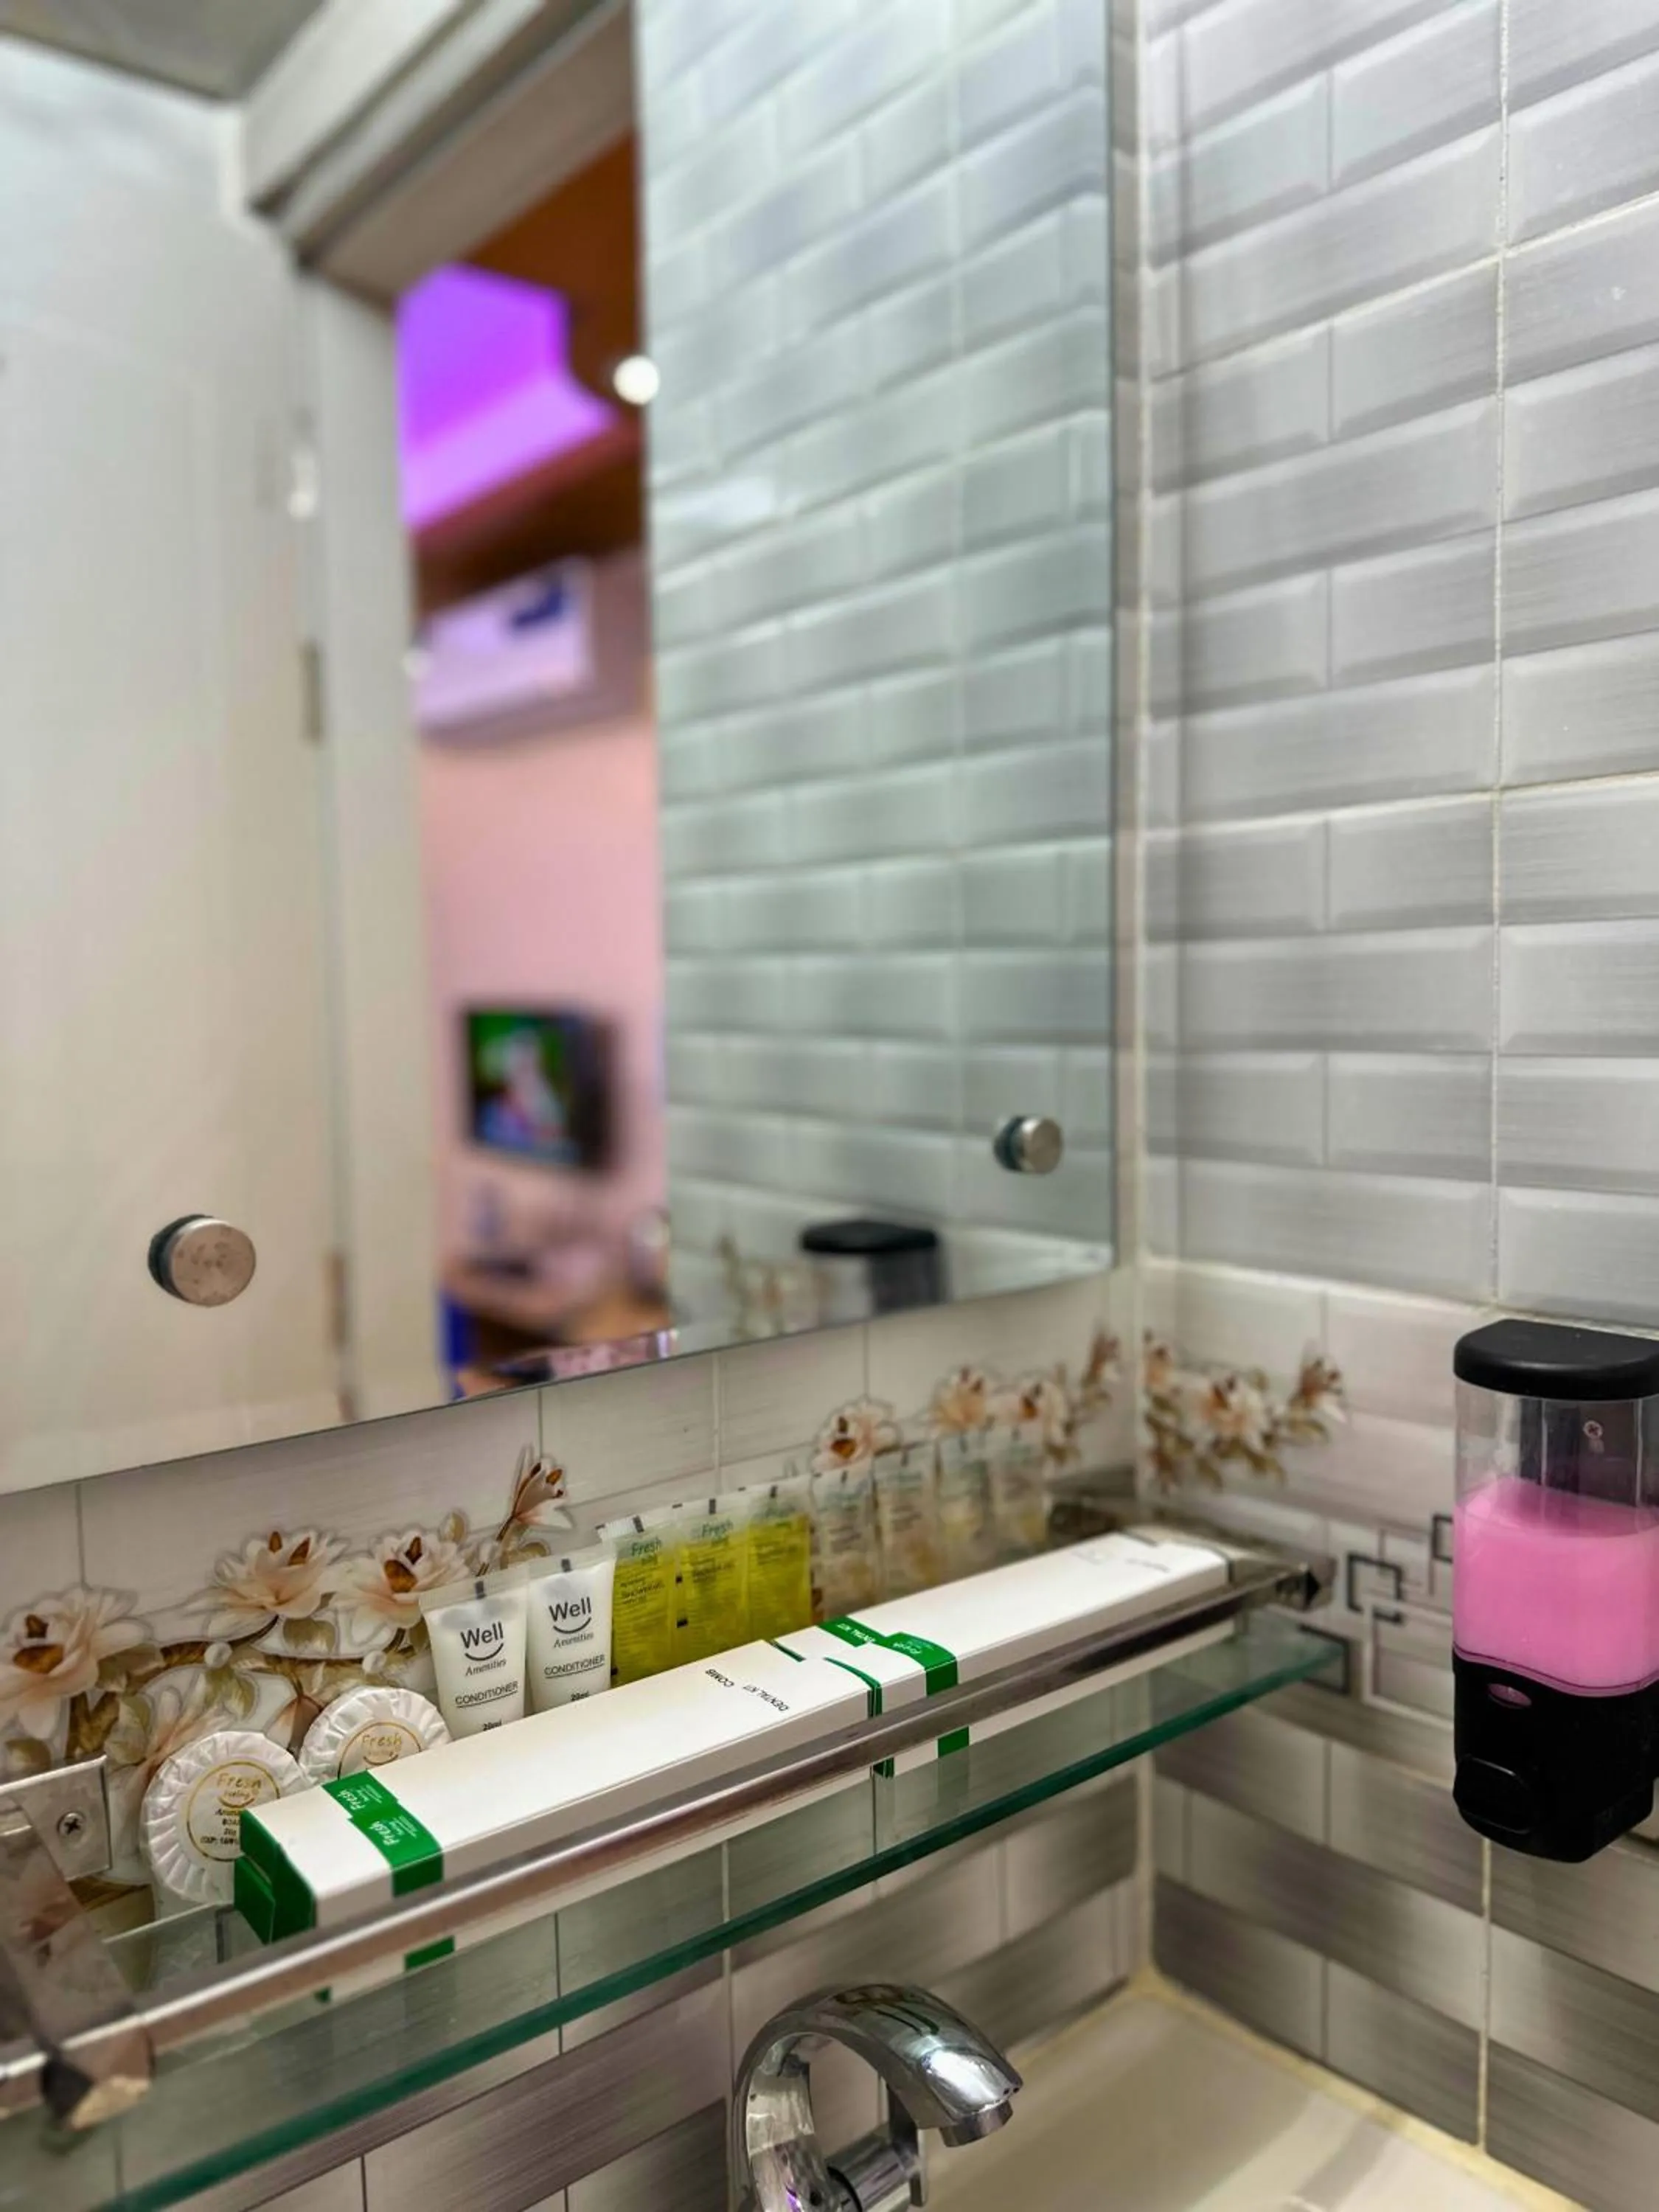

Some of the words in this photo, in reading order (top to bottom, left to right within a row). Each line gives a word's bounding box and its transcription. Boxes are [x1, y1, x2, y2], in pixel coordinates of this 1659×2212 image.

[549, 1596, 591, 1622] Well
[461, 1621, 504, 1649] Well
[554, 1631, 594, 1649] Amenities
[465, 1659, 507, 1676] Amenities
[544, 1654, 605, 1676] CONDITIONER
[455, 1681, 518, 1706] CONDITIONER
